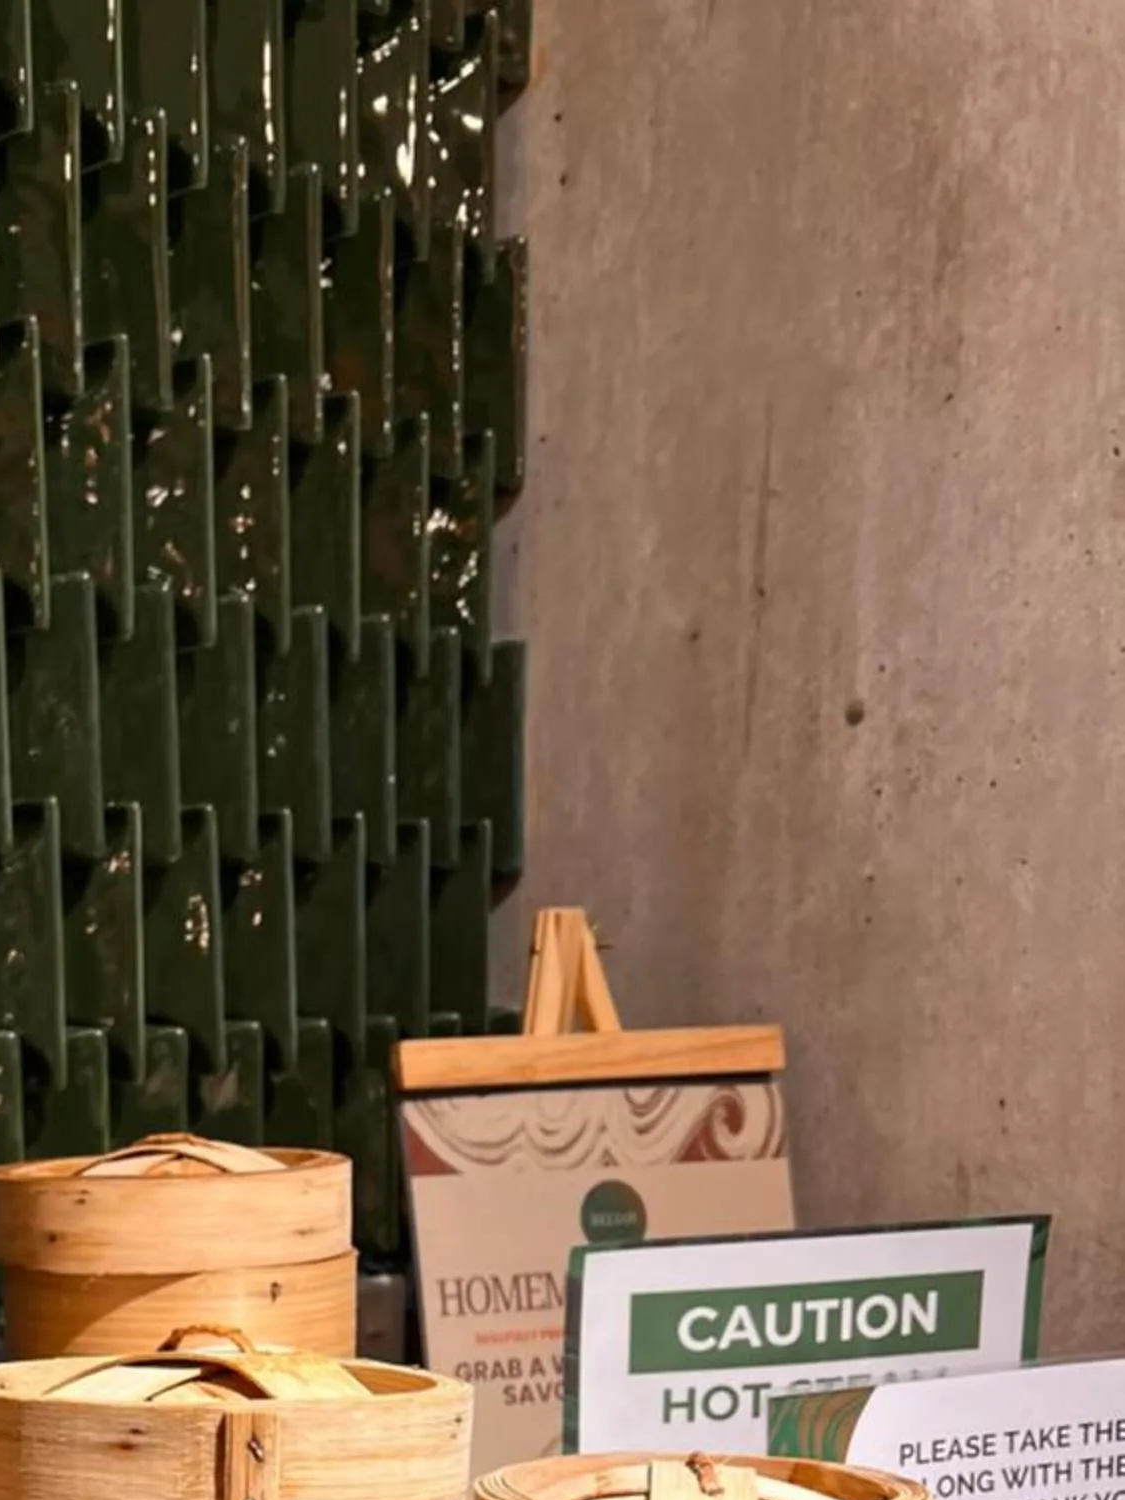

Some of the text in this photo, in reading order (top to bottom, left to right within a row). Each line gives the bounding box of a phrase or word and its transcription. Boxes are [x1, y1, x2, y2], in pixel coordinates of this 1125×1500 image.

[678, 1290, 938, 1351] CAUTION
[455, 1357, 523, 1382] GRAB
[530, 1356, 546, 1378] A
[662, 1382, 772, 1423] HOT
[899, 1433, 997, 1467] PLEASE
[1004, 1425, 1072, 1454] TAKE
[1001, 1461, 1073, 1490] WITH
